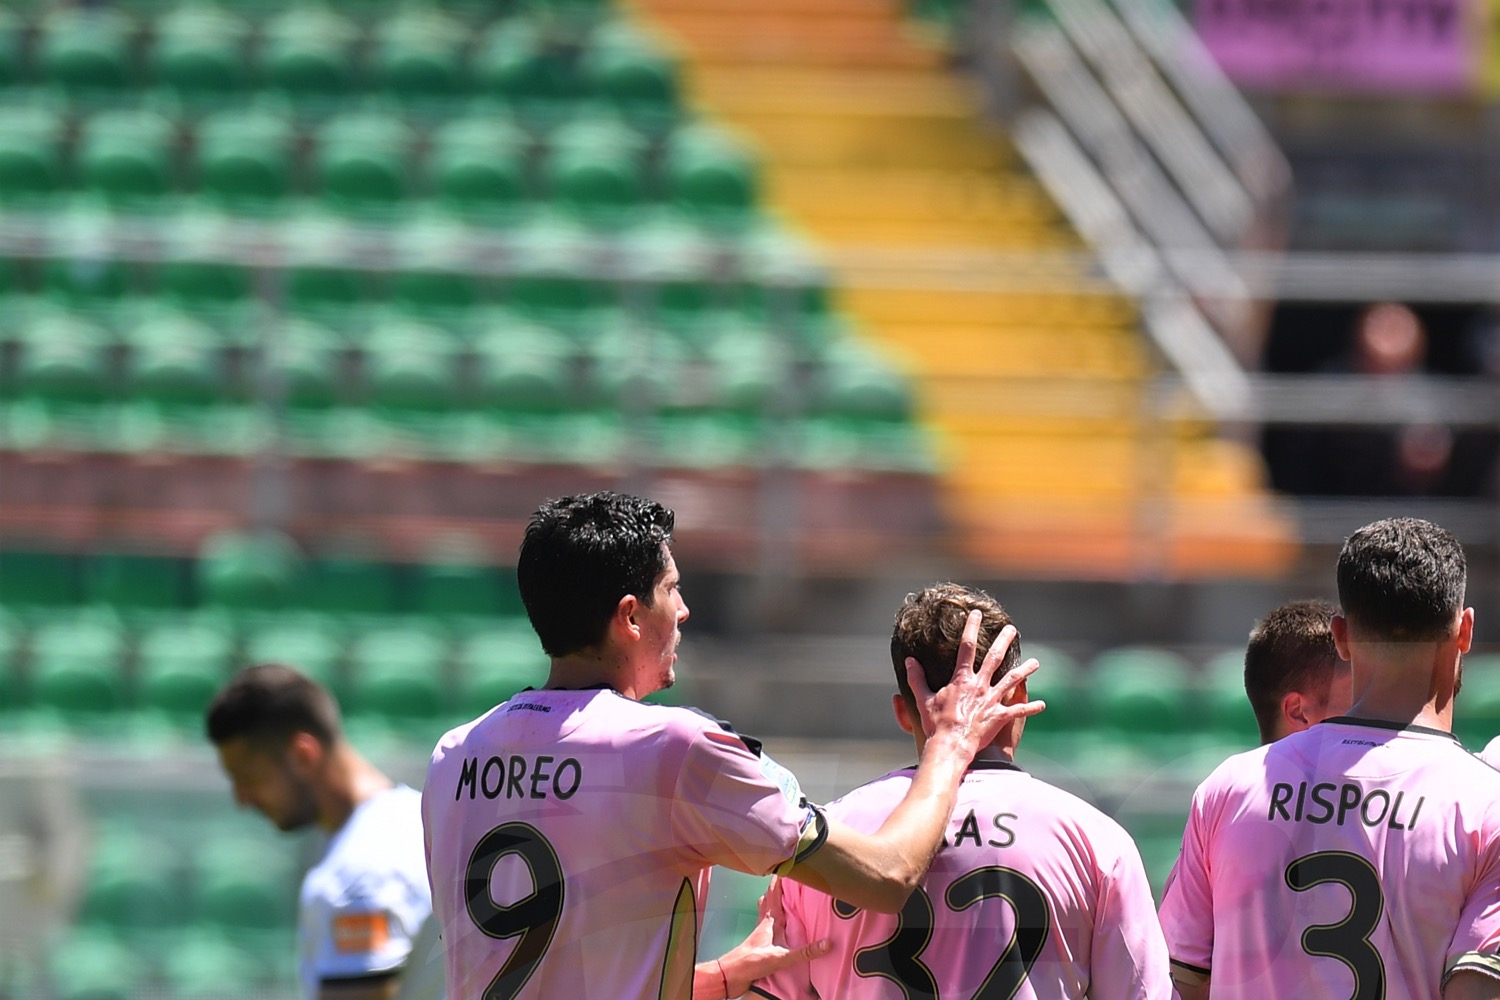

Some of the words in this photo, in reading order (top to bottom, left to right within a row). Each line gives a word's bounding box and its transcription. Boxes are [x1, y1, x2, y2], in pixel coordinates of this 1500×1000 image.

[455, 755, 583, 802] MOREO
[941, 808, 1019, 848] AS
[1267, 780, 1426, 831] RISPOLI
